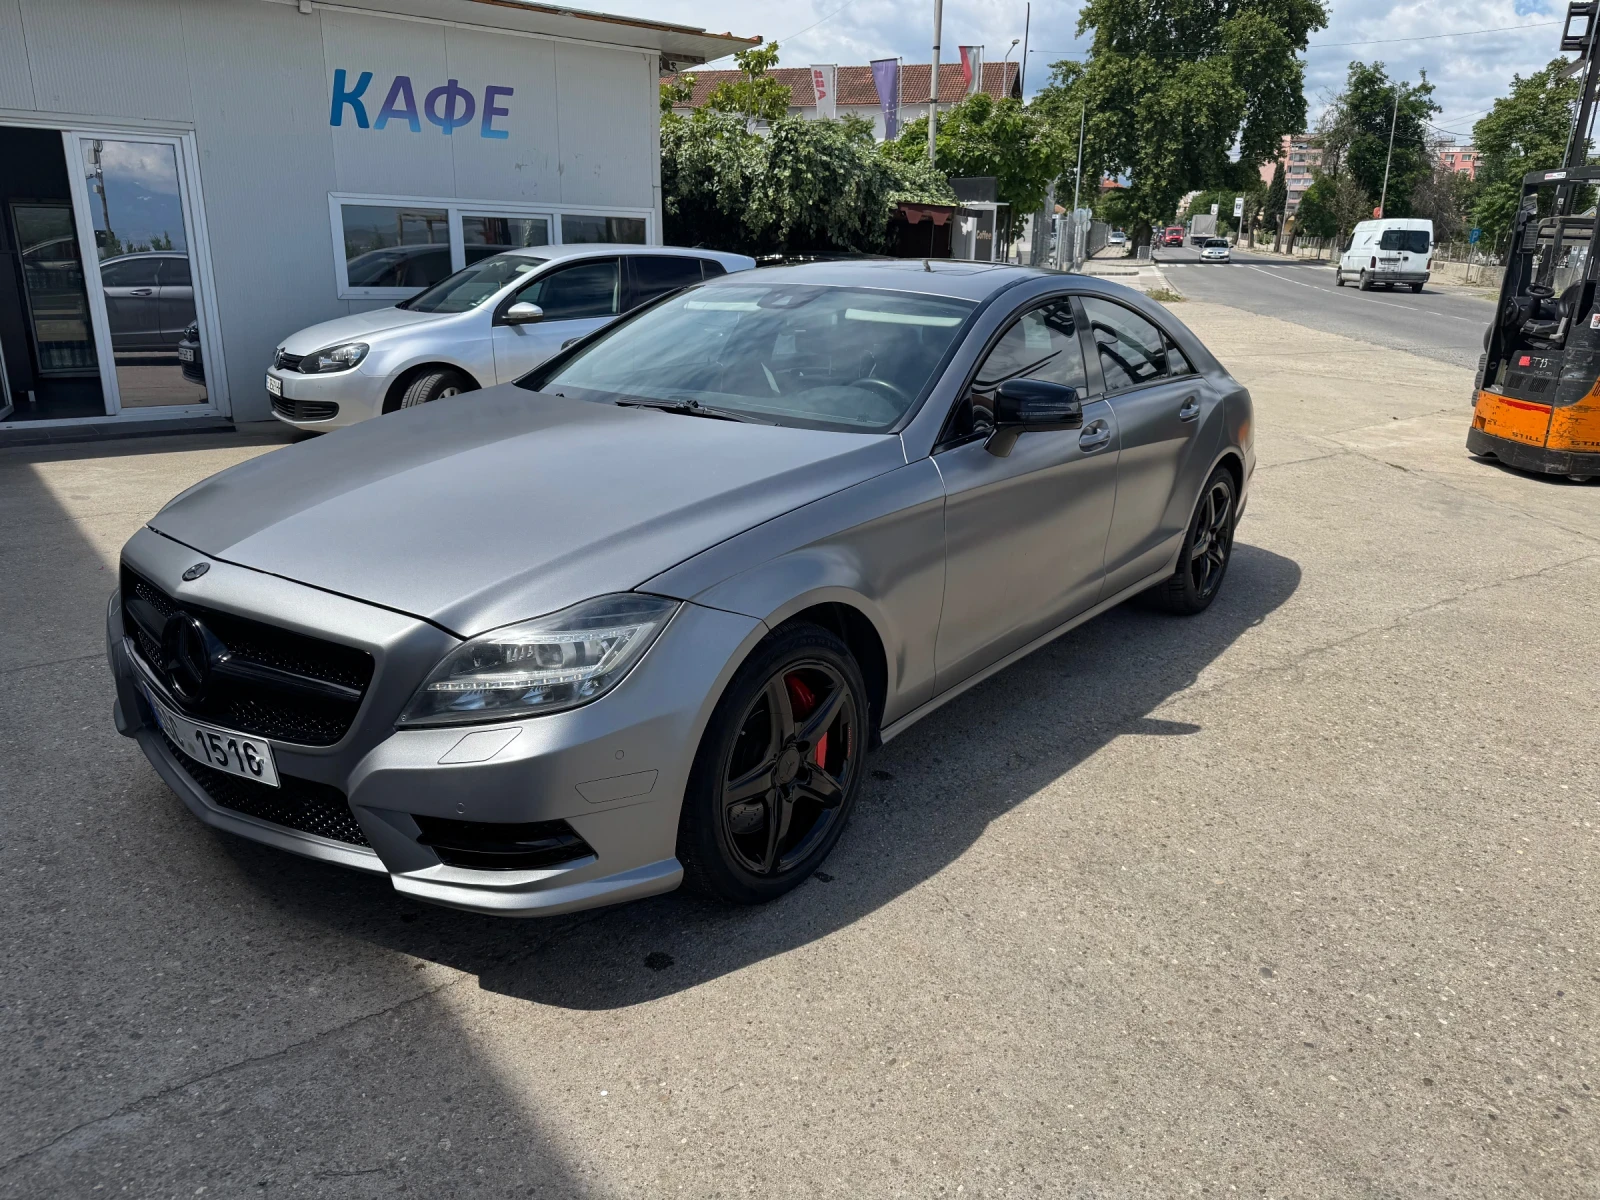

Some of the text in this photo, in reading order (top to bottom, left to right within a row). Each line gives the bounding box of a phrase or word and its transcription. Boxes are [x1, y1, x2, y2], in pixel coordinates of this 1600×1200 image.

[329, 68, 515, 140] КАФЕ
[1471, 230, 1479, 242] P
[1512, 431, 1542, 443] STILL
[195, 728, 265, 777] 1516
